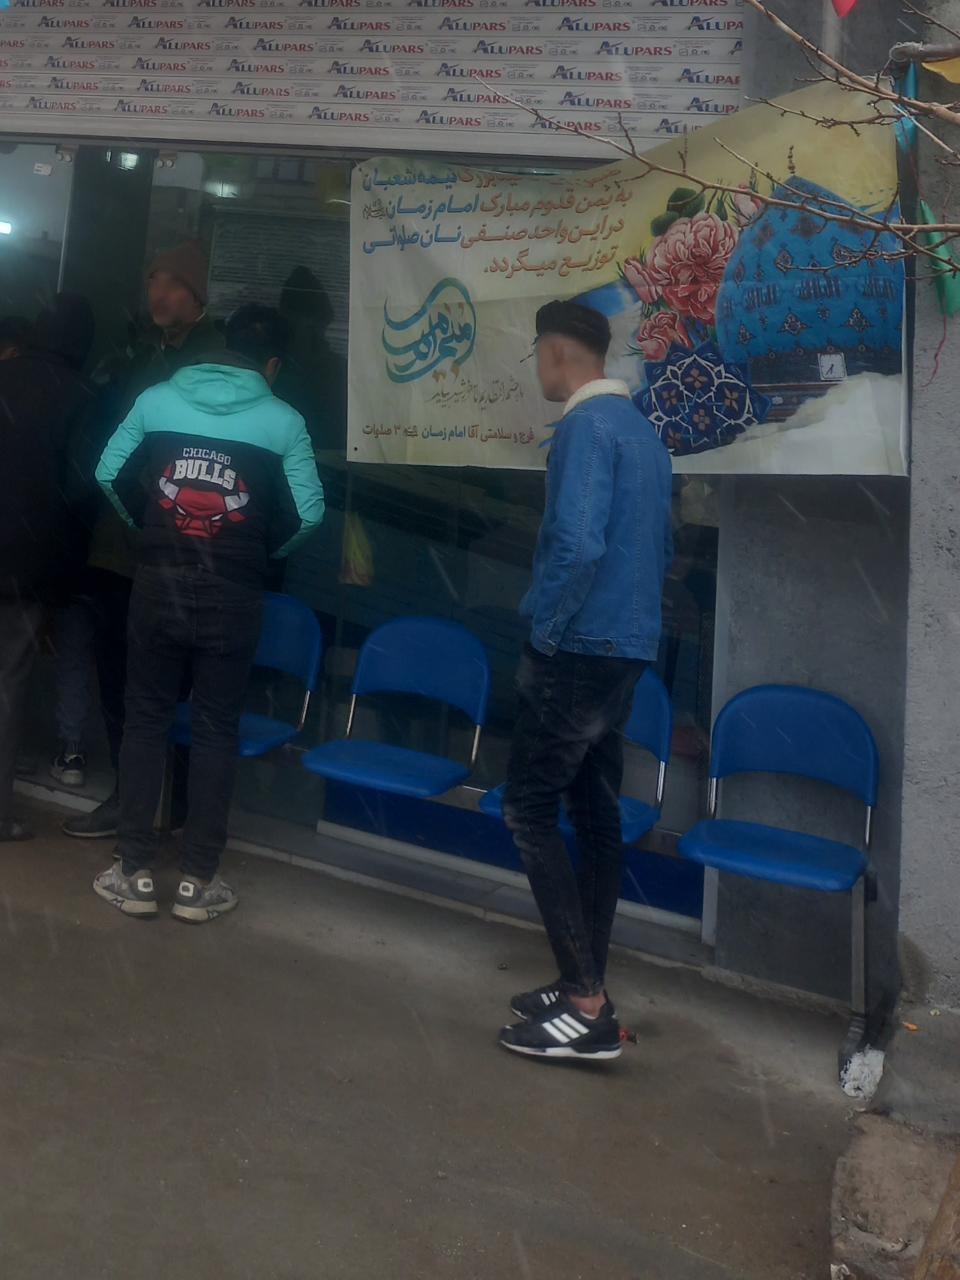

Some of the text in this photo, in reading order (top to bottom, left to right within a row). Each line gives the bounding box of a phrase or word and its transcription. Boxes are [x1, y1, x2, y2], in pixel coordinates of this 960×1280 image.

[386, 195, 433, 219] زمان
[432, 193, 480, 221] امام
[480, 192, 530, 217] مبارک
[420, 223, 462, 248] نان
[461, 223, 528, 249] صنفی
[528, 218, 569, 244] واحد
[568, 215, 608, 243] این
[602, 218, 625, 240] در
[559, 245, 619, 277] توزیع
[421, 425, 447, 440] زمان
[448, 425, 466, 441] امام
[182, 447, 231, 465] CHICAGO
[173, 459, 237, 491] BULLS
